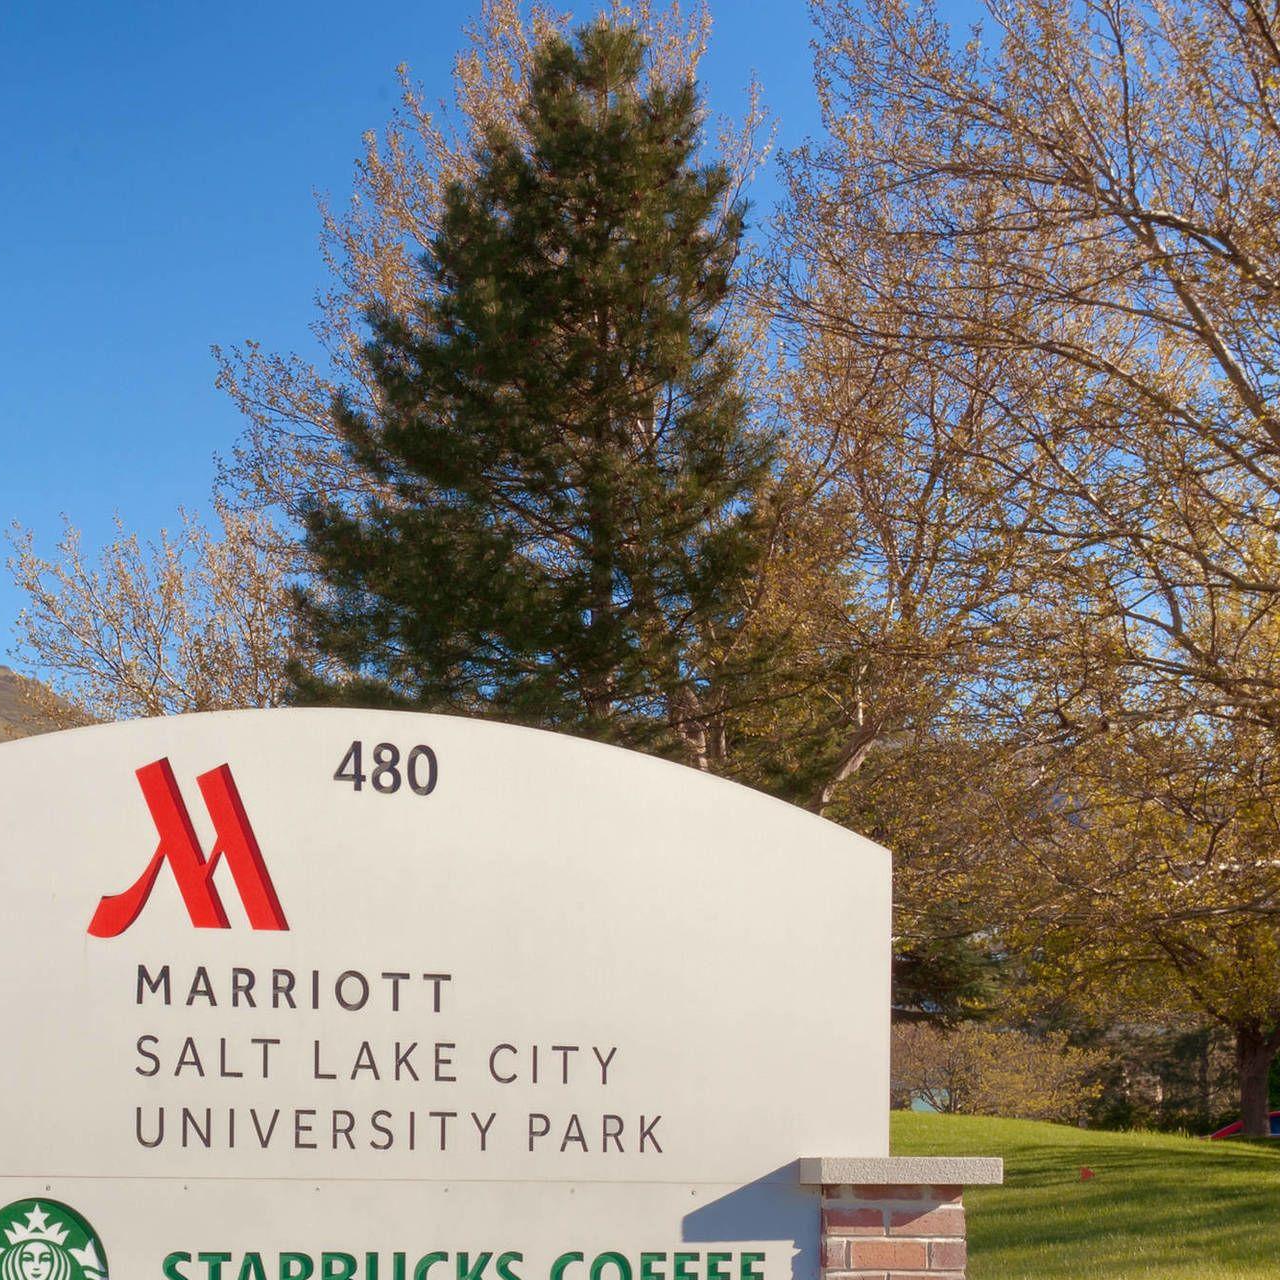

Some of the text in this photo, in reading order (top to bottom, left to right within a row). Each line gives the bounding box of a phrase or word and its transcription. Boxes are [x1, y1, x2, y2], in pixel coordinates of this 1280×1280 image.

[333, 741, 439, 797] 480
[137, 964, 452, 1013] MARRIOTT
[135, 1034, 618, 1086] SALT LAKE CITY
[135, 1106, 663, 1154] UNIVERSITY PARK
